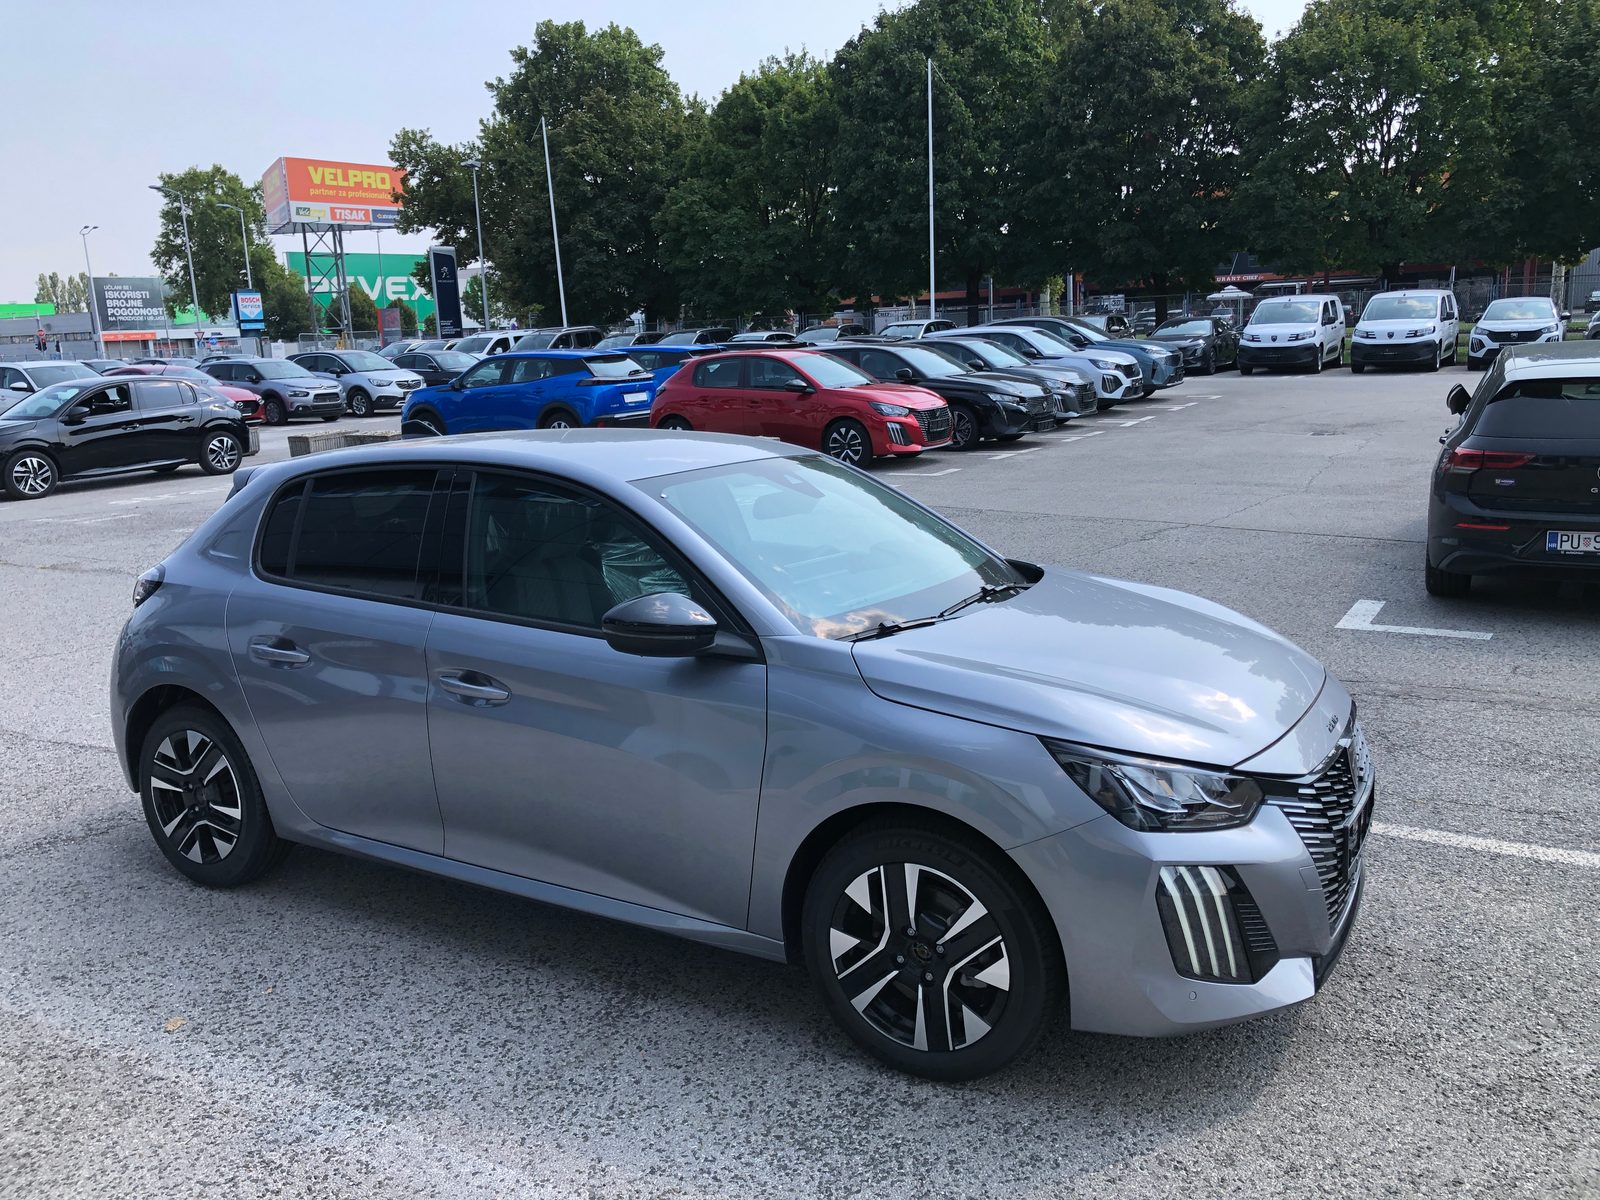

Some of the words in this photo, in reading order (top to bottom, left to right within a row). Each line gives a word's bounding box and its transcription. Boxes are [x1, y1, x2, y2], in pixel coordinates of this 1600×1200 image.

[308, 166, 391, 190] VELPRO
[310, 188, 337, 197] partner
[334, 209, 366, 220] TISAK
[105, 290, 149, 299] ISKORISTI
[106, 299, 144, 308] BROJNE
[1560, 534, 1581, 549] PU
